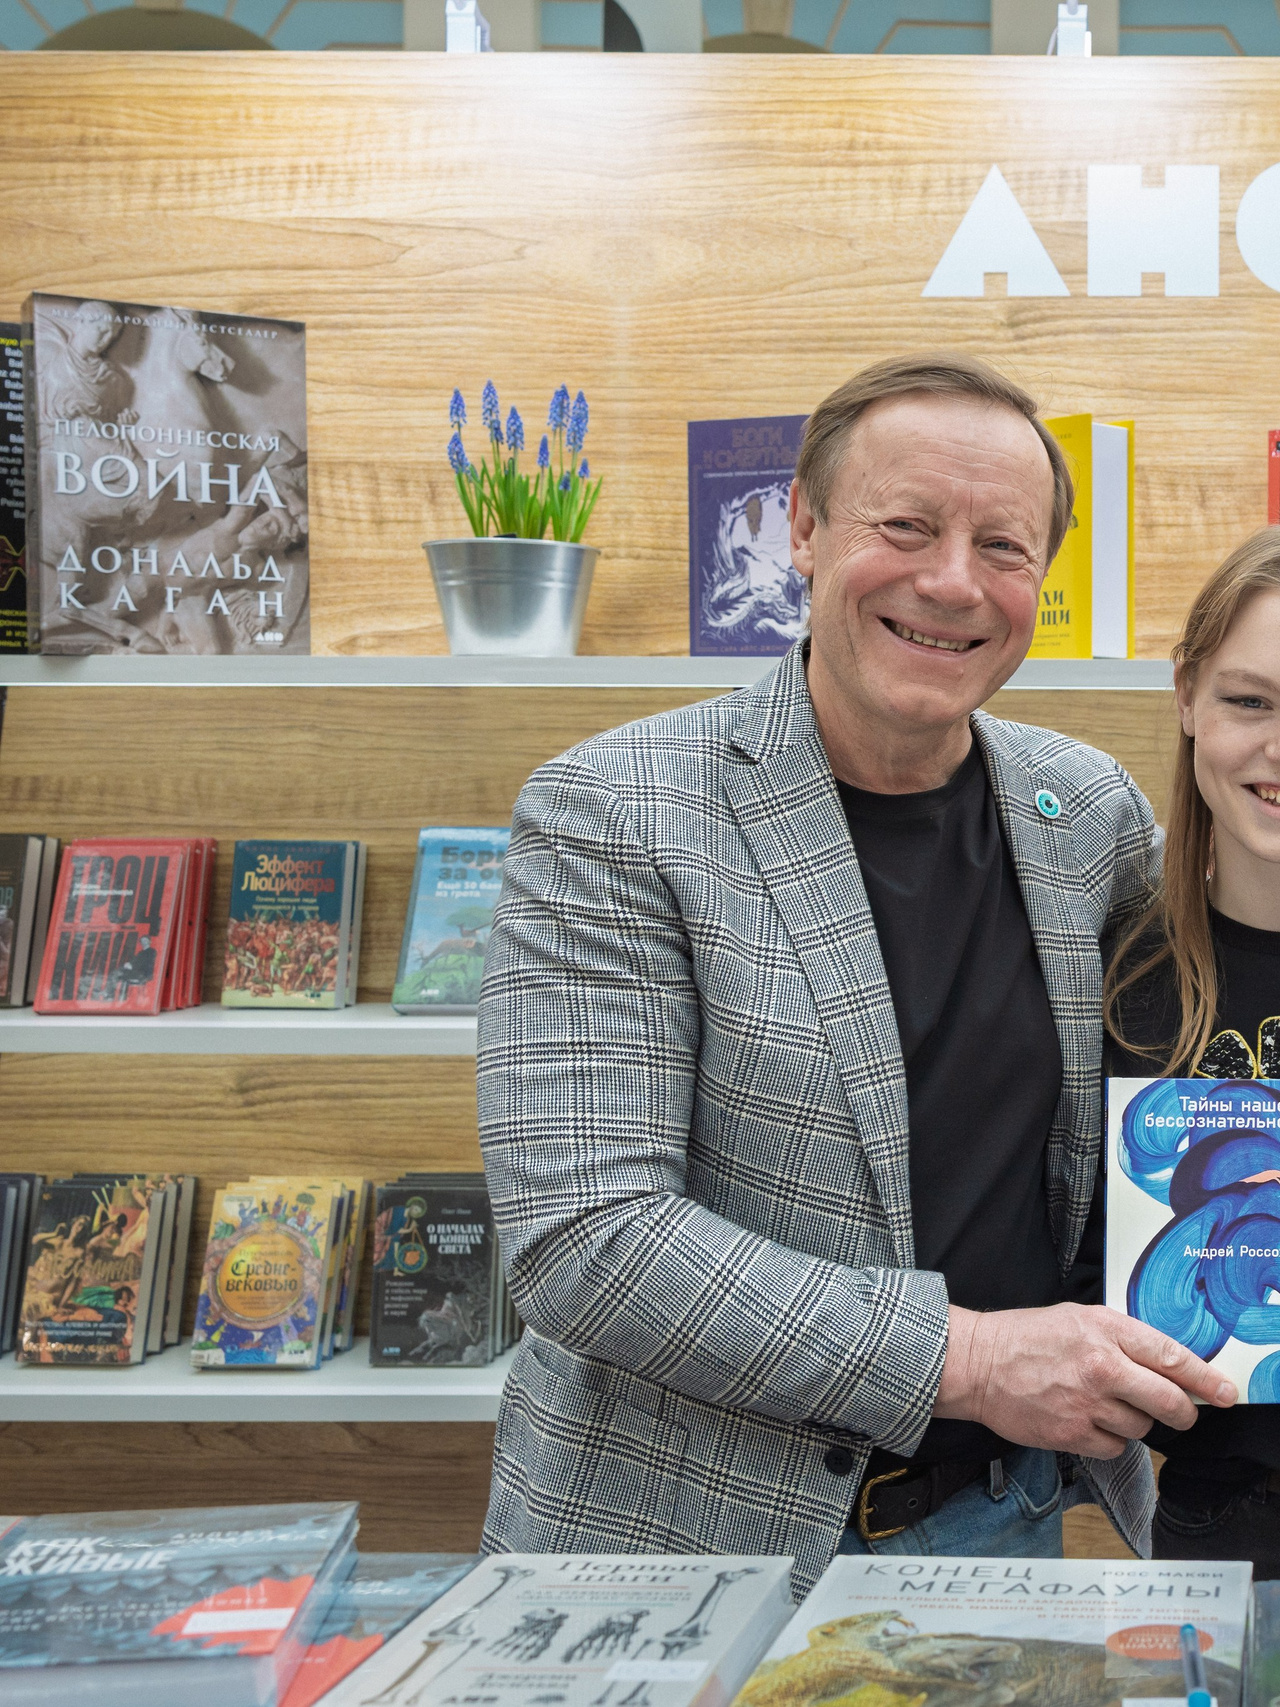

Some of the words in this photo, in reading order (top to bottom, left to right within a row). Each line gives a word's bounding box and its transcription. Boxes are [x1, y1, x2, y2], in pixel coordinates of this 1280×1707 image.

[54, 418, 281, 452] ПЕЛОПОННЕССКАЯ
[54, 447, 287, 508] ВОЙНА
[57, 544, 286, 583] ДОНАЛЬД
[59, 582, 285, 618] КАГАН
[255, 854, 325, 878] Эффект
[241, 871, 336, 896] Люцифера
[1179, 1096, 1233, 1113] Тайны
[1183, 1245, 1234, 1259] Андрей
[9, 1535, 107, 1558] КАК
[0, 1548, 179, 1577] ЖИВЫЕ
[556, 1560, 710, 1577] Первые
[864, 1563, 1032, 1581] КОНЕЦ
[570, 1574, 674, 1585] шаги
[1158, 1571, 1224, 1579] МАКФИ
[899, 1580, 1222, 1598] МЕГАФАУНЫ
